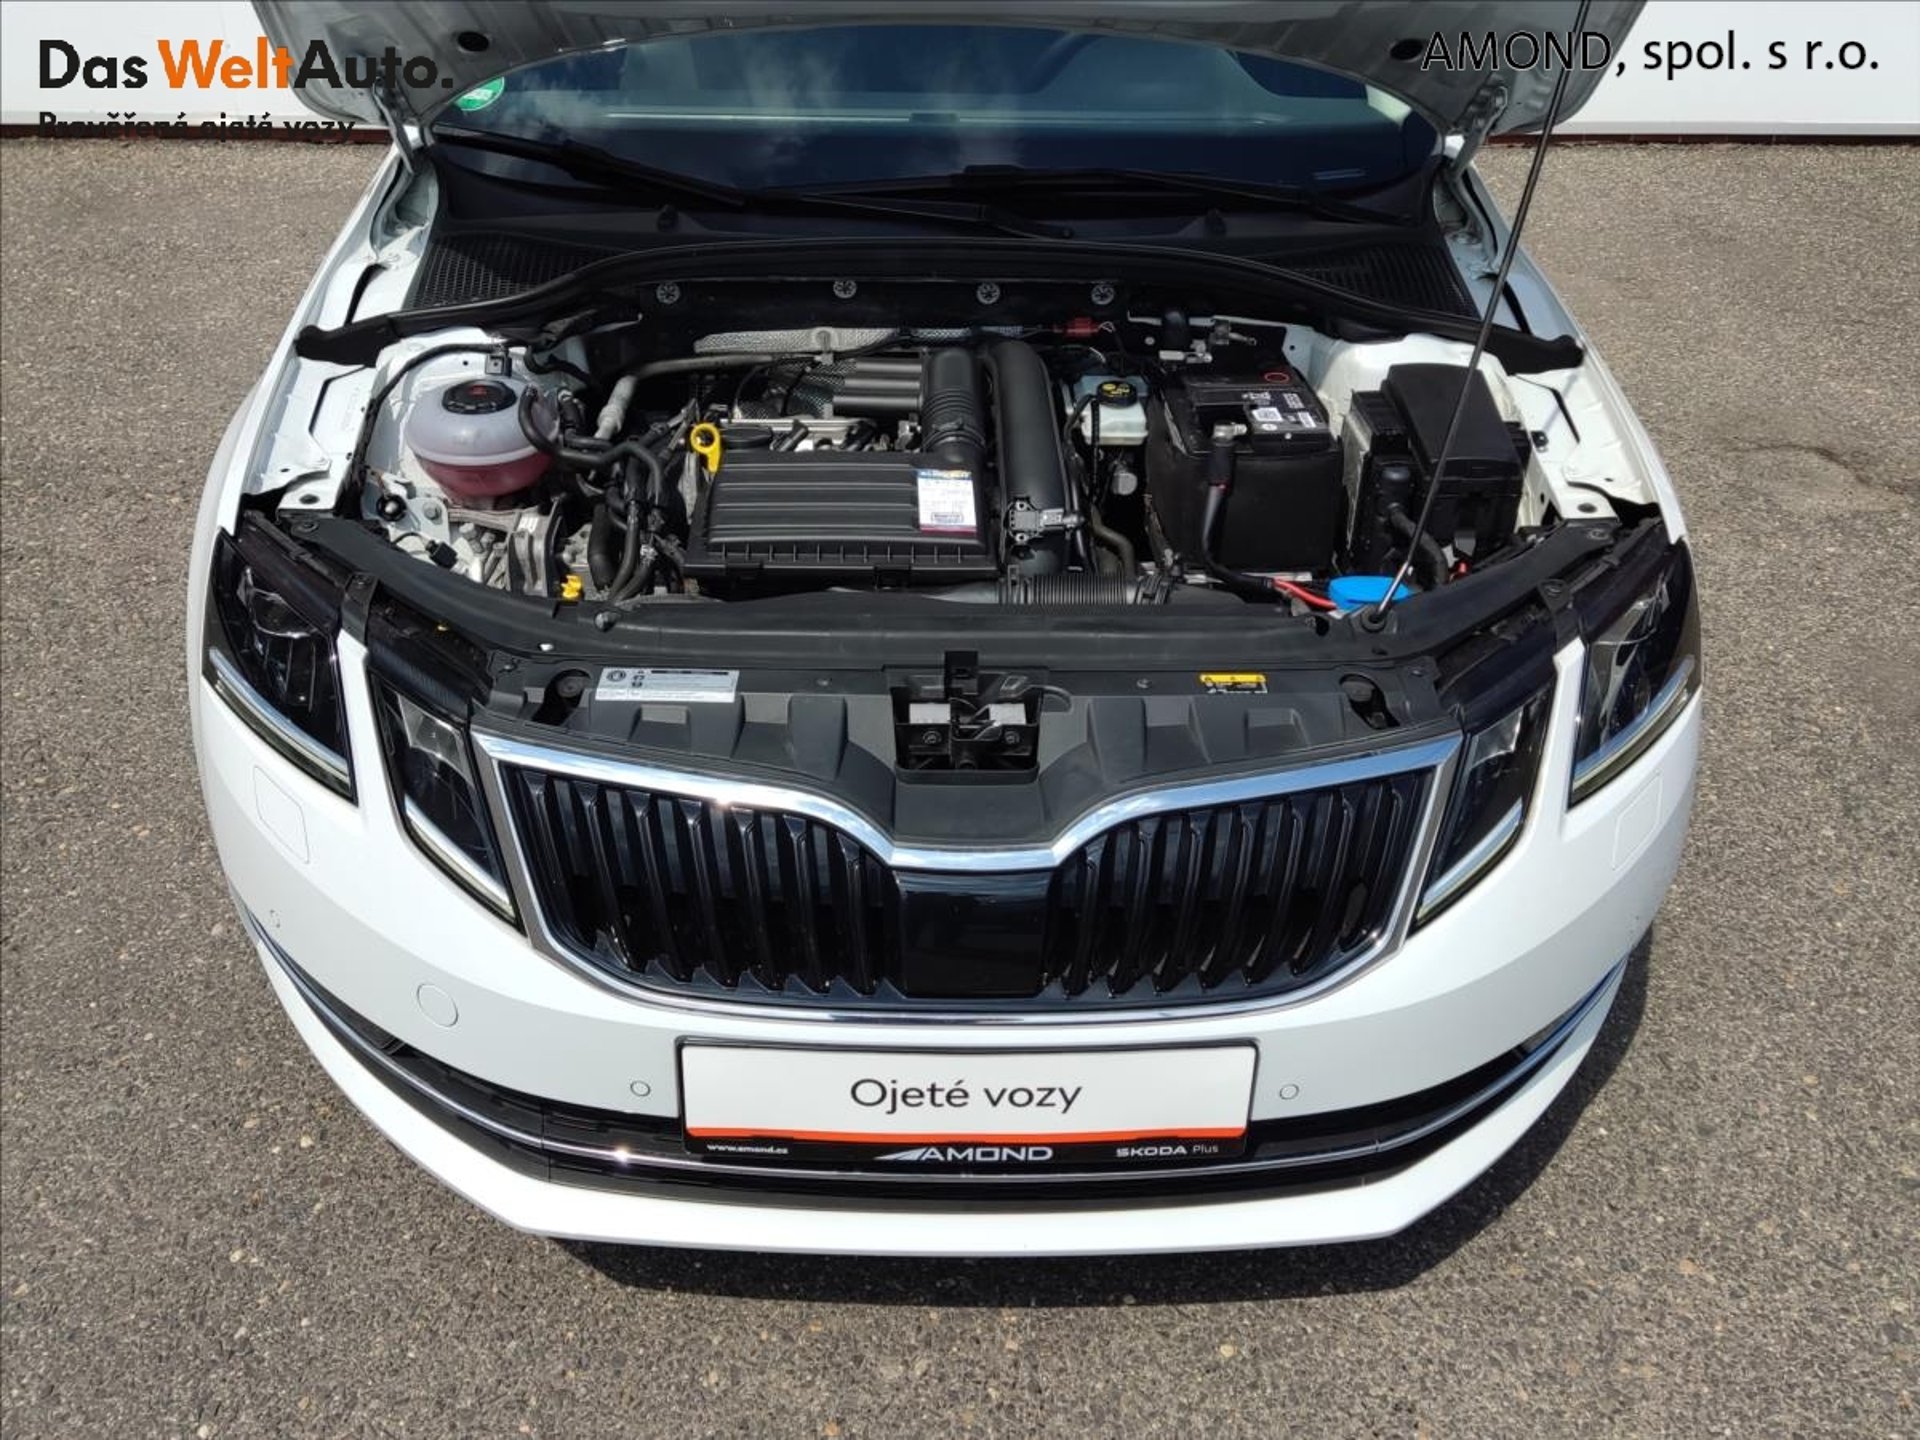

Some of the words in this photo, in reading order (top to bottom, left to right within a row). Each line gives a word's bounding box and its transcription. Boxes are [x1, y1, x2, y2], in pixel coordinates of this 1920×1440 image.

[850, 1078, 969, 1115] Ojeté
[984, 1085, 1082, 1115] vozy
[920, 1147, 1053, 1161] AMOND
[1193, 1144, 1219, 1155] Plus
